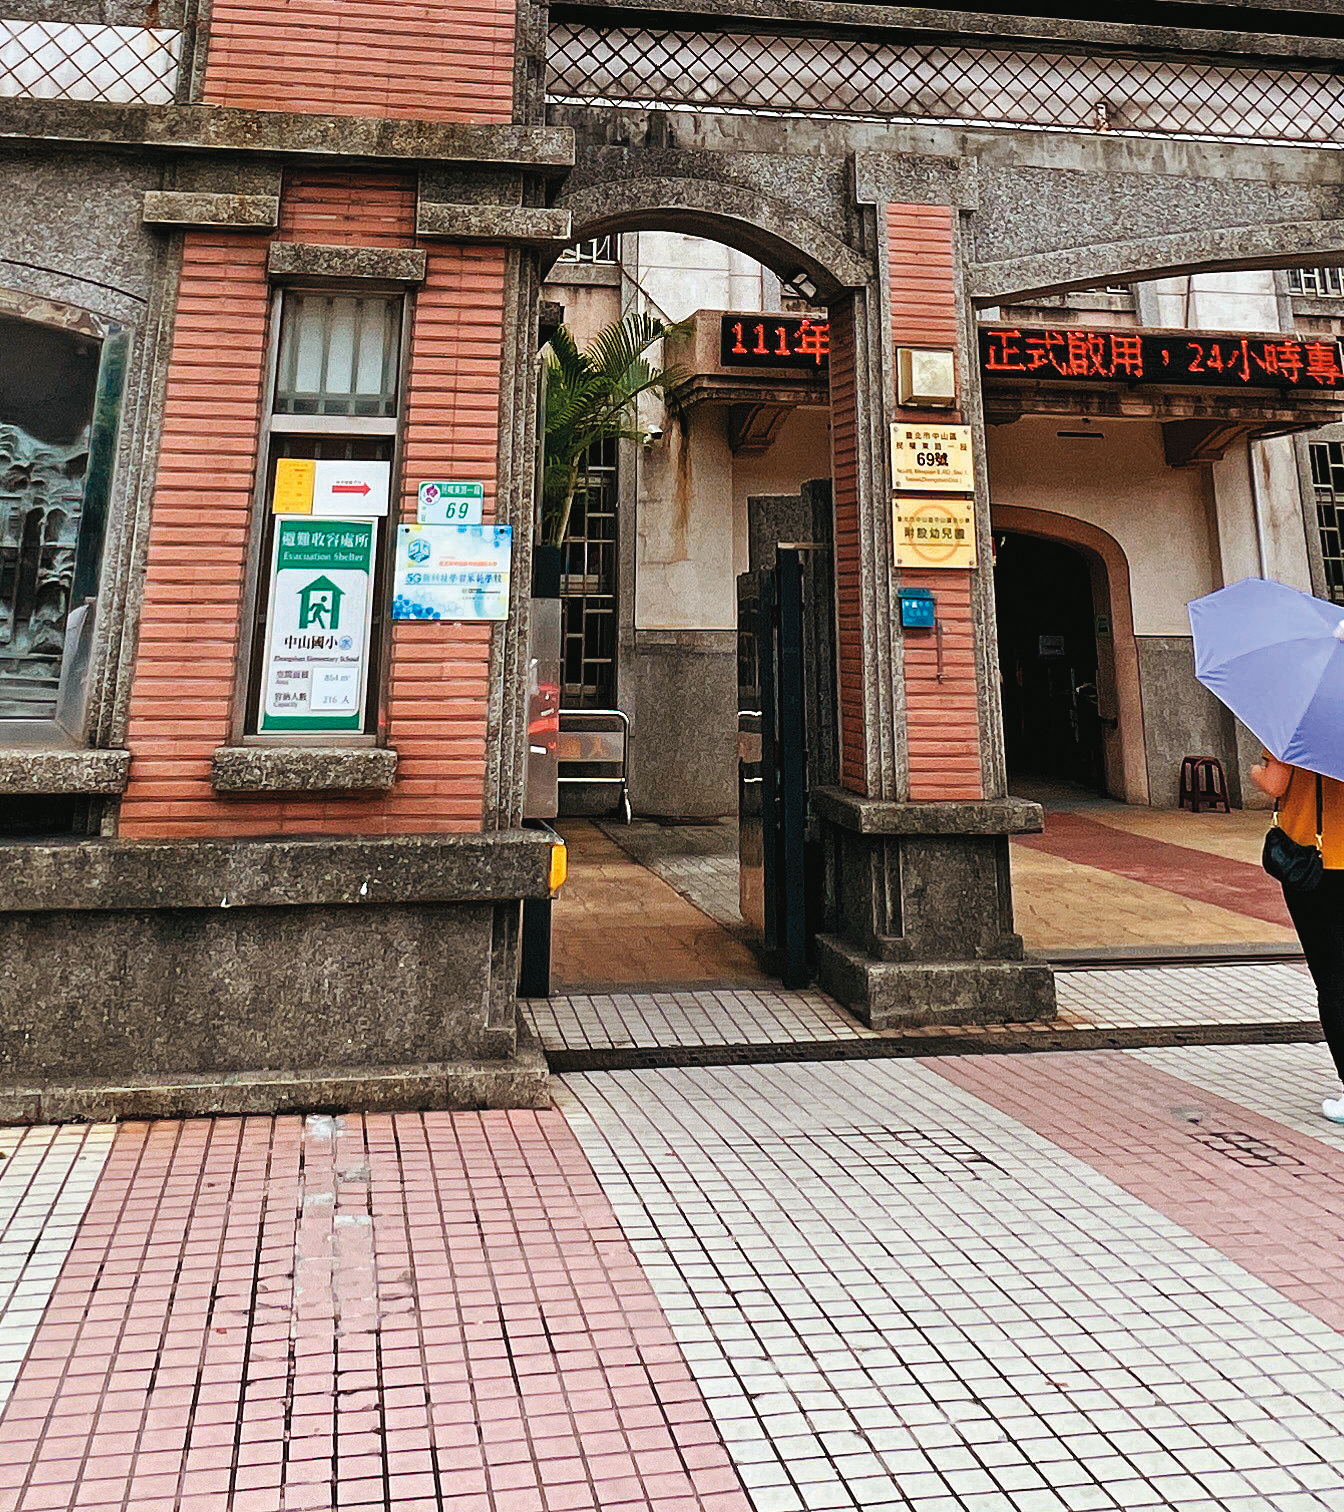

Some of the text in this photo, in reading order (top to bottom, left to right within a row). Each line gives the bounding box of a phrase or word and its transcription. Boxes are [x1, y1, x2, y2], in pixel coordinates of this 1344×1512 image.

[730, 319, 831, 366] 111年
[905, 431, 958, 441] 臺北市中山區
[916, 451, 950, 467] 69號
[446, 502, 469, 519] 69
[282, 531, 369, 548] 避難收容處所
[904, 526, 966, 540] 附設幼兒園
[333, 551, 364, 562] Shelter
[284, 635, 338, 649] 中山國小
